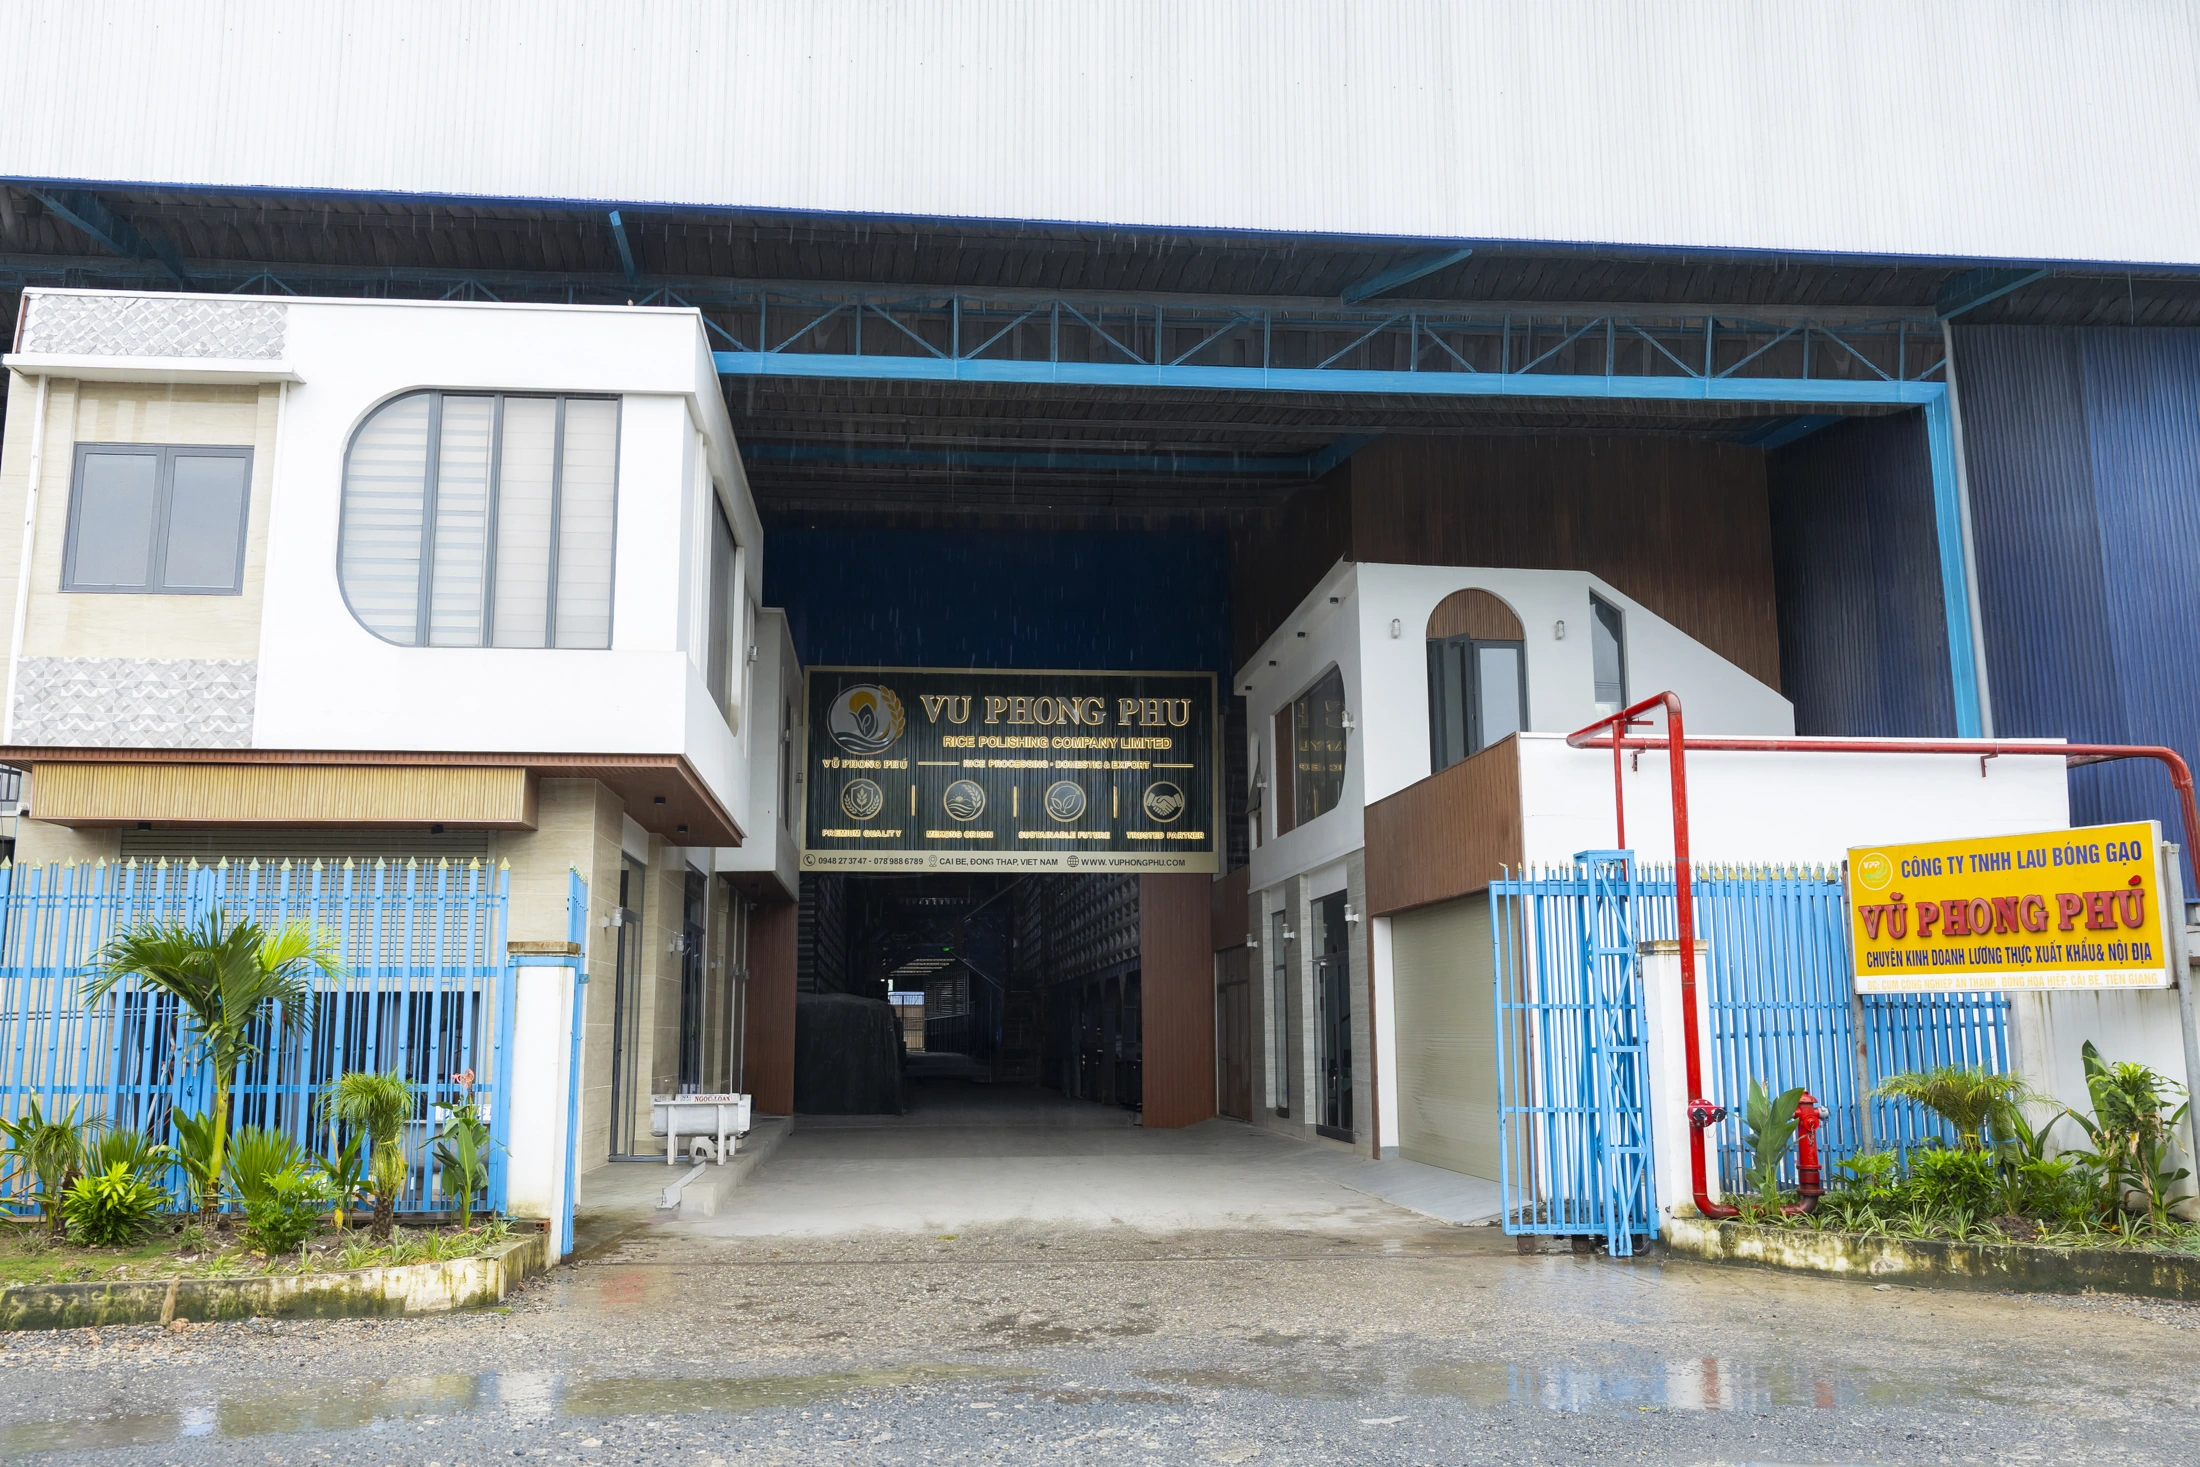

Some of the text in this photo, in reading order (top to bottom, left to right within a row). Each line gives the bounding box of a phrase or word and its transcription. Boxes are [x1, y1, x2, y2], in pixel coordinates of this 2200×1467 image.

[919, 694, 1192, 727] VU PHONG PHU
[942, 735, 1172, 750] RICE POLISHING COMPANY LIMITED
[841, 759, 882, 769] PHONG
[962, 759, 986, 768] RICE
[988, 759, 1049, 769] PROCESSING
[1054, 760, 1103, 770] DOMESTIC
[1111, 761, 1150, 770] EXPORT
[822, 829, 902, 838] PREMIUM QUALITY
[926, 830, 994, 839] MEKONG ORIGIN
[1018, 831, 1111, 839] SUSTAINABLE FUTURE
[1126, 831, 1205, 840] TRUSTED PARTNER
[939, 858, 954, 866] CAI
[1020, 859, 1038, 867] VIET
[1901, 840, 2142, 878] CÔNG TY TNHH LAU BÓNG GẠO
[1863, 861, 1880, 869] VPP
[1858, 874, 2145, 940] VŨ PHONG PHÚ
[1866, 948, 1903, 968] CHUYÊN
[1905, 948, 1929, 967] KINH
[1931, 947, 1965, 966] DOANH
[1969, 945, 2002, 965] LƯƠNG
[2005, 944, 2032, 967] THỰC
[2035, 939, 2062, 964] XUẤT
[2108, 939, 2128, 964] NỘI
[2132, 941, 2153, 964] ĐỊA
[1955, 978, 1967, 988] AN
[2129, 973, 2158, 985] GIANG
